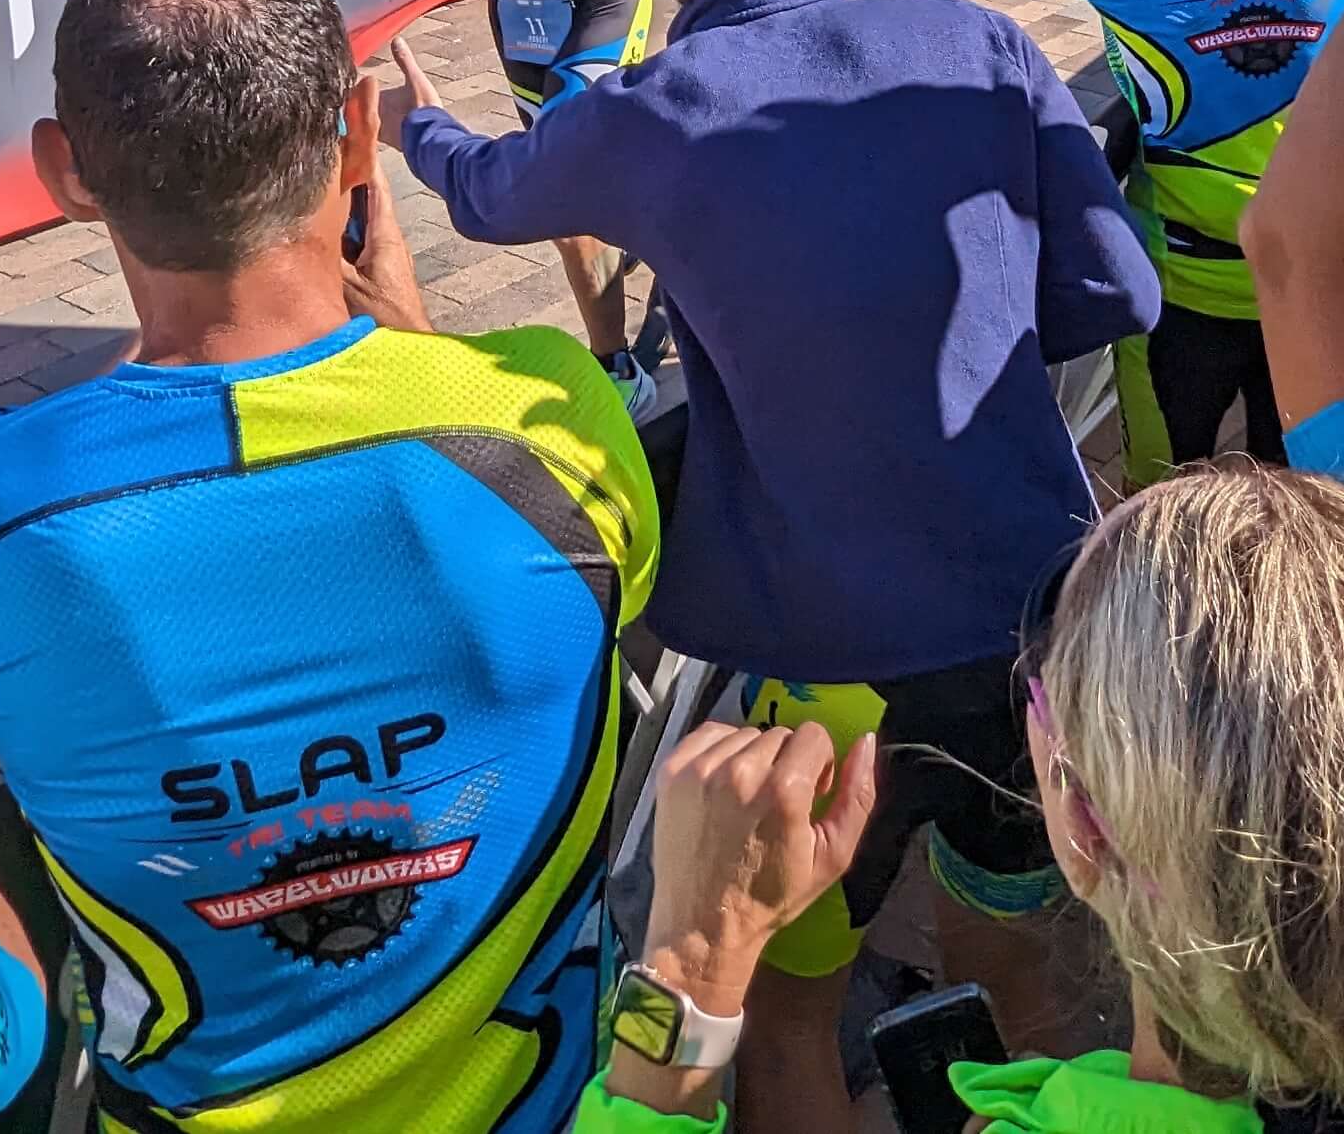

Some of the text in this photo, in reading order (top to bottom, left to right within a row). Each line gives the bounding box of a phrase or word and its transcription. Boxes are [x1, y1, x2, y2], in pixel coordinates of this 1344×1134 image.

[525, 17, 546, 36] 11
[160, 711, 448, 824] SLAP
[227, 799, 413, 858] TRI TEAM
[206, 848, 462, 921] WHEELWORKS
